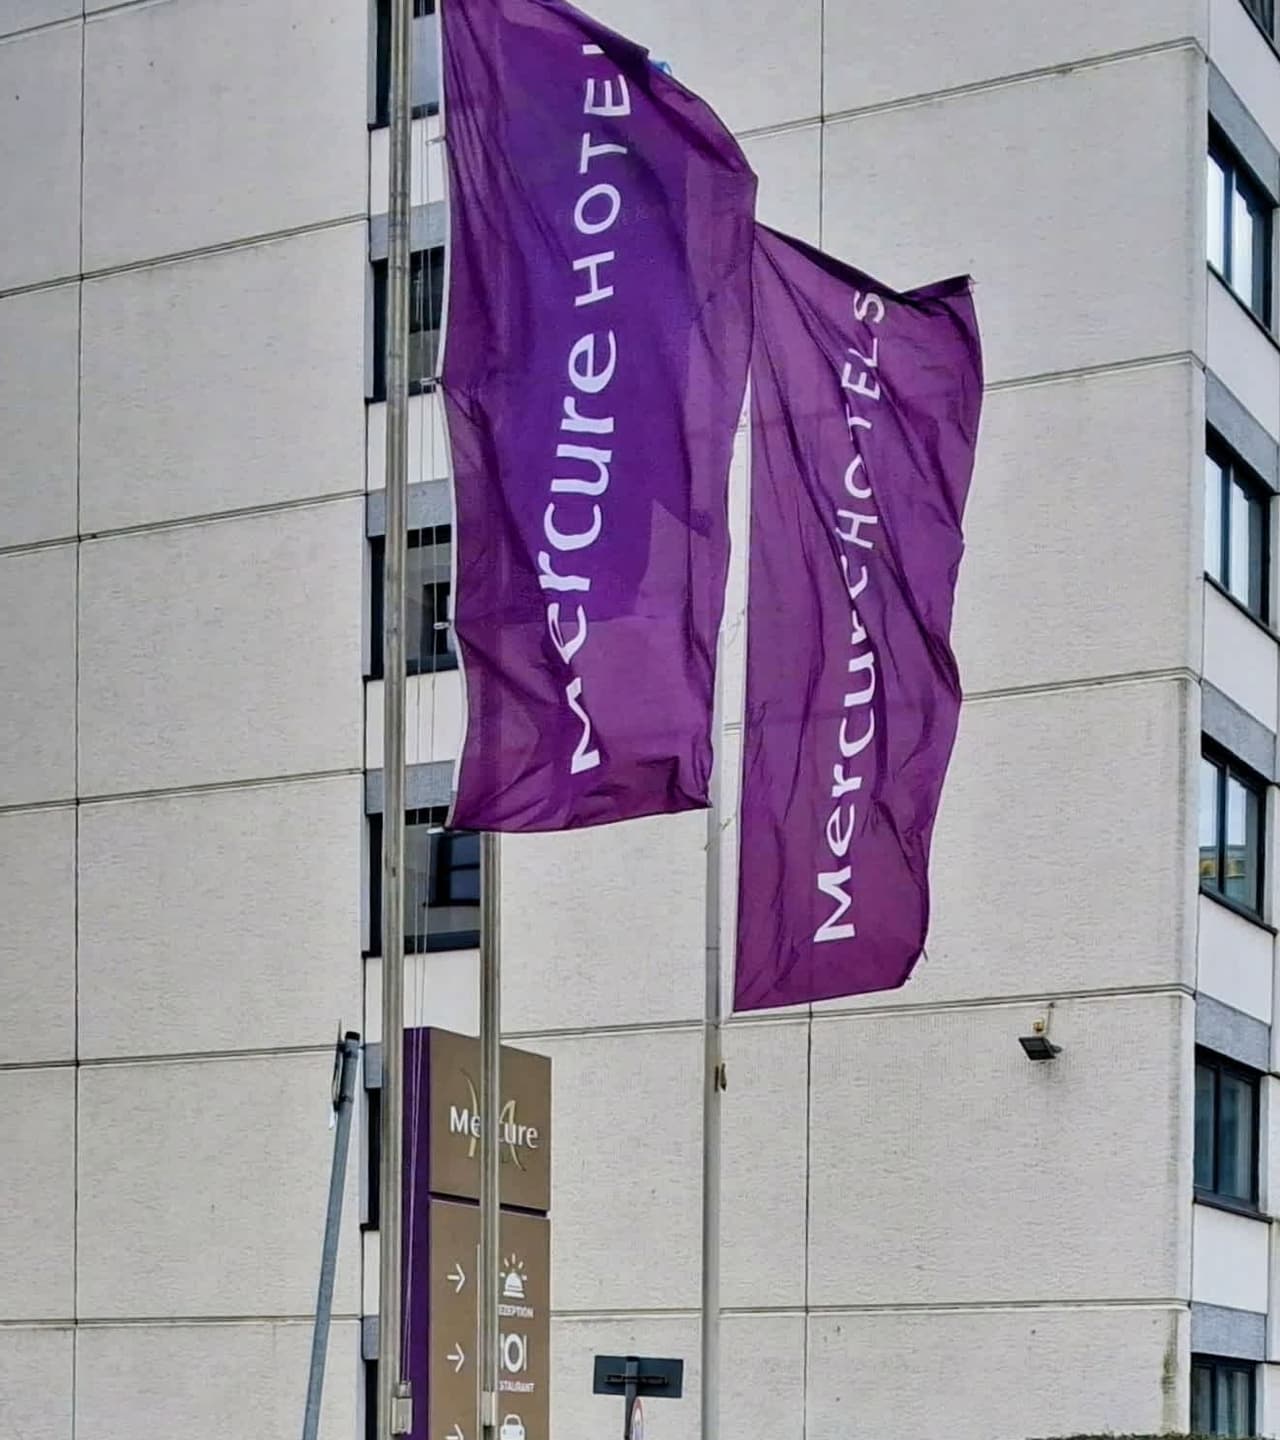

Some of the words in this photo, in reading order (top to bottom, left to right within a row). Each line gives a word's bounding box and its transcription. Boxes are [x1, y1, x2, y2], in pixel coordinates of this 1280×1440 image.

[538, 329, 618, 776] Mercure
[813, 554, 877, 943] Mercure
[449, 1105, 539, 1150] Meure
[499, 1380, 535, 1393] STAURANT
